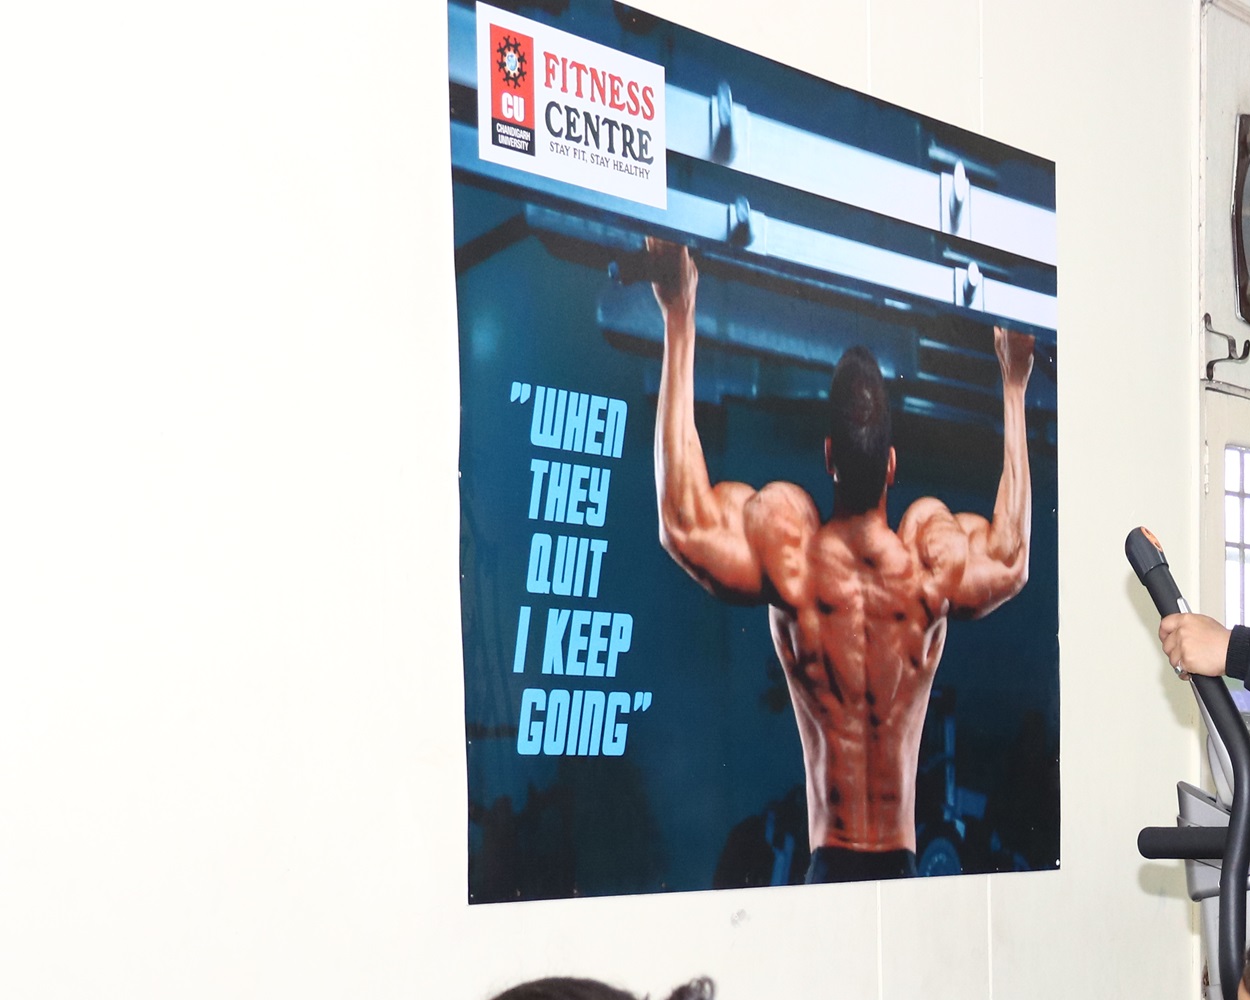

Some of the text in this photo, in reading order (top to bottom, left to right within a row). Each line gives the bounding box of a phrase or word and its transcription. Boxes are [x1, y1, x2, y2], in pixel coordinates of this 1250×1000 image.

[501, 92, 525, 122] CU
[543, 51, 655, 121] FITNESS
[496, 122, 531, 141] CHANDIGARH
[498, 134, 529, 151] UNIVERSITY
[545, 101, 654, 165] CENTRE
[549, 141, 651, 180] STAY FIT, STAY HEALTHY
[528, 458, 611, 527] THEY
[526, 532, 609, 598] QUIT
[513, 605, 634, 678] I KEEP
